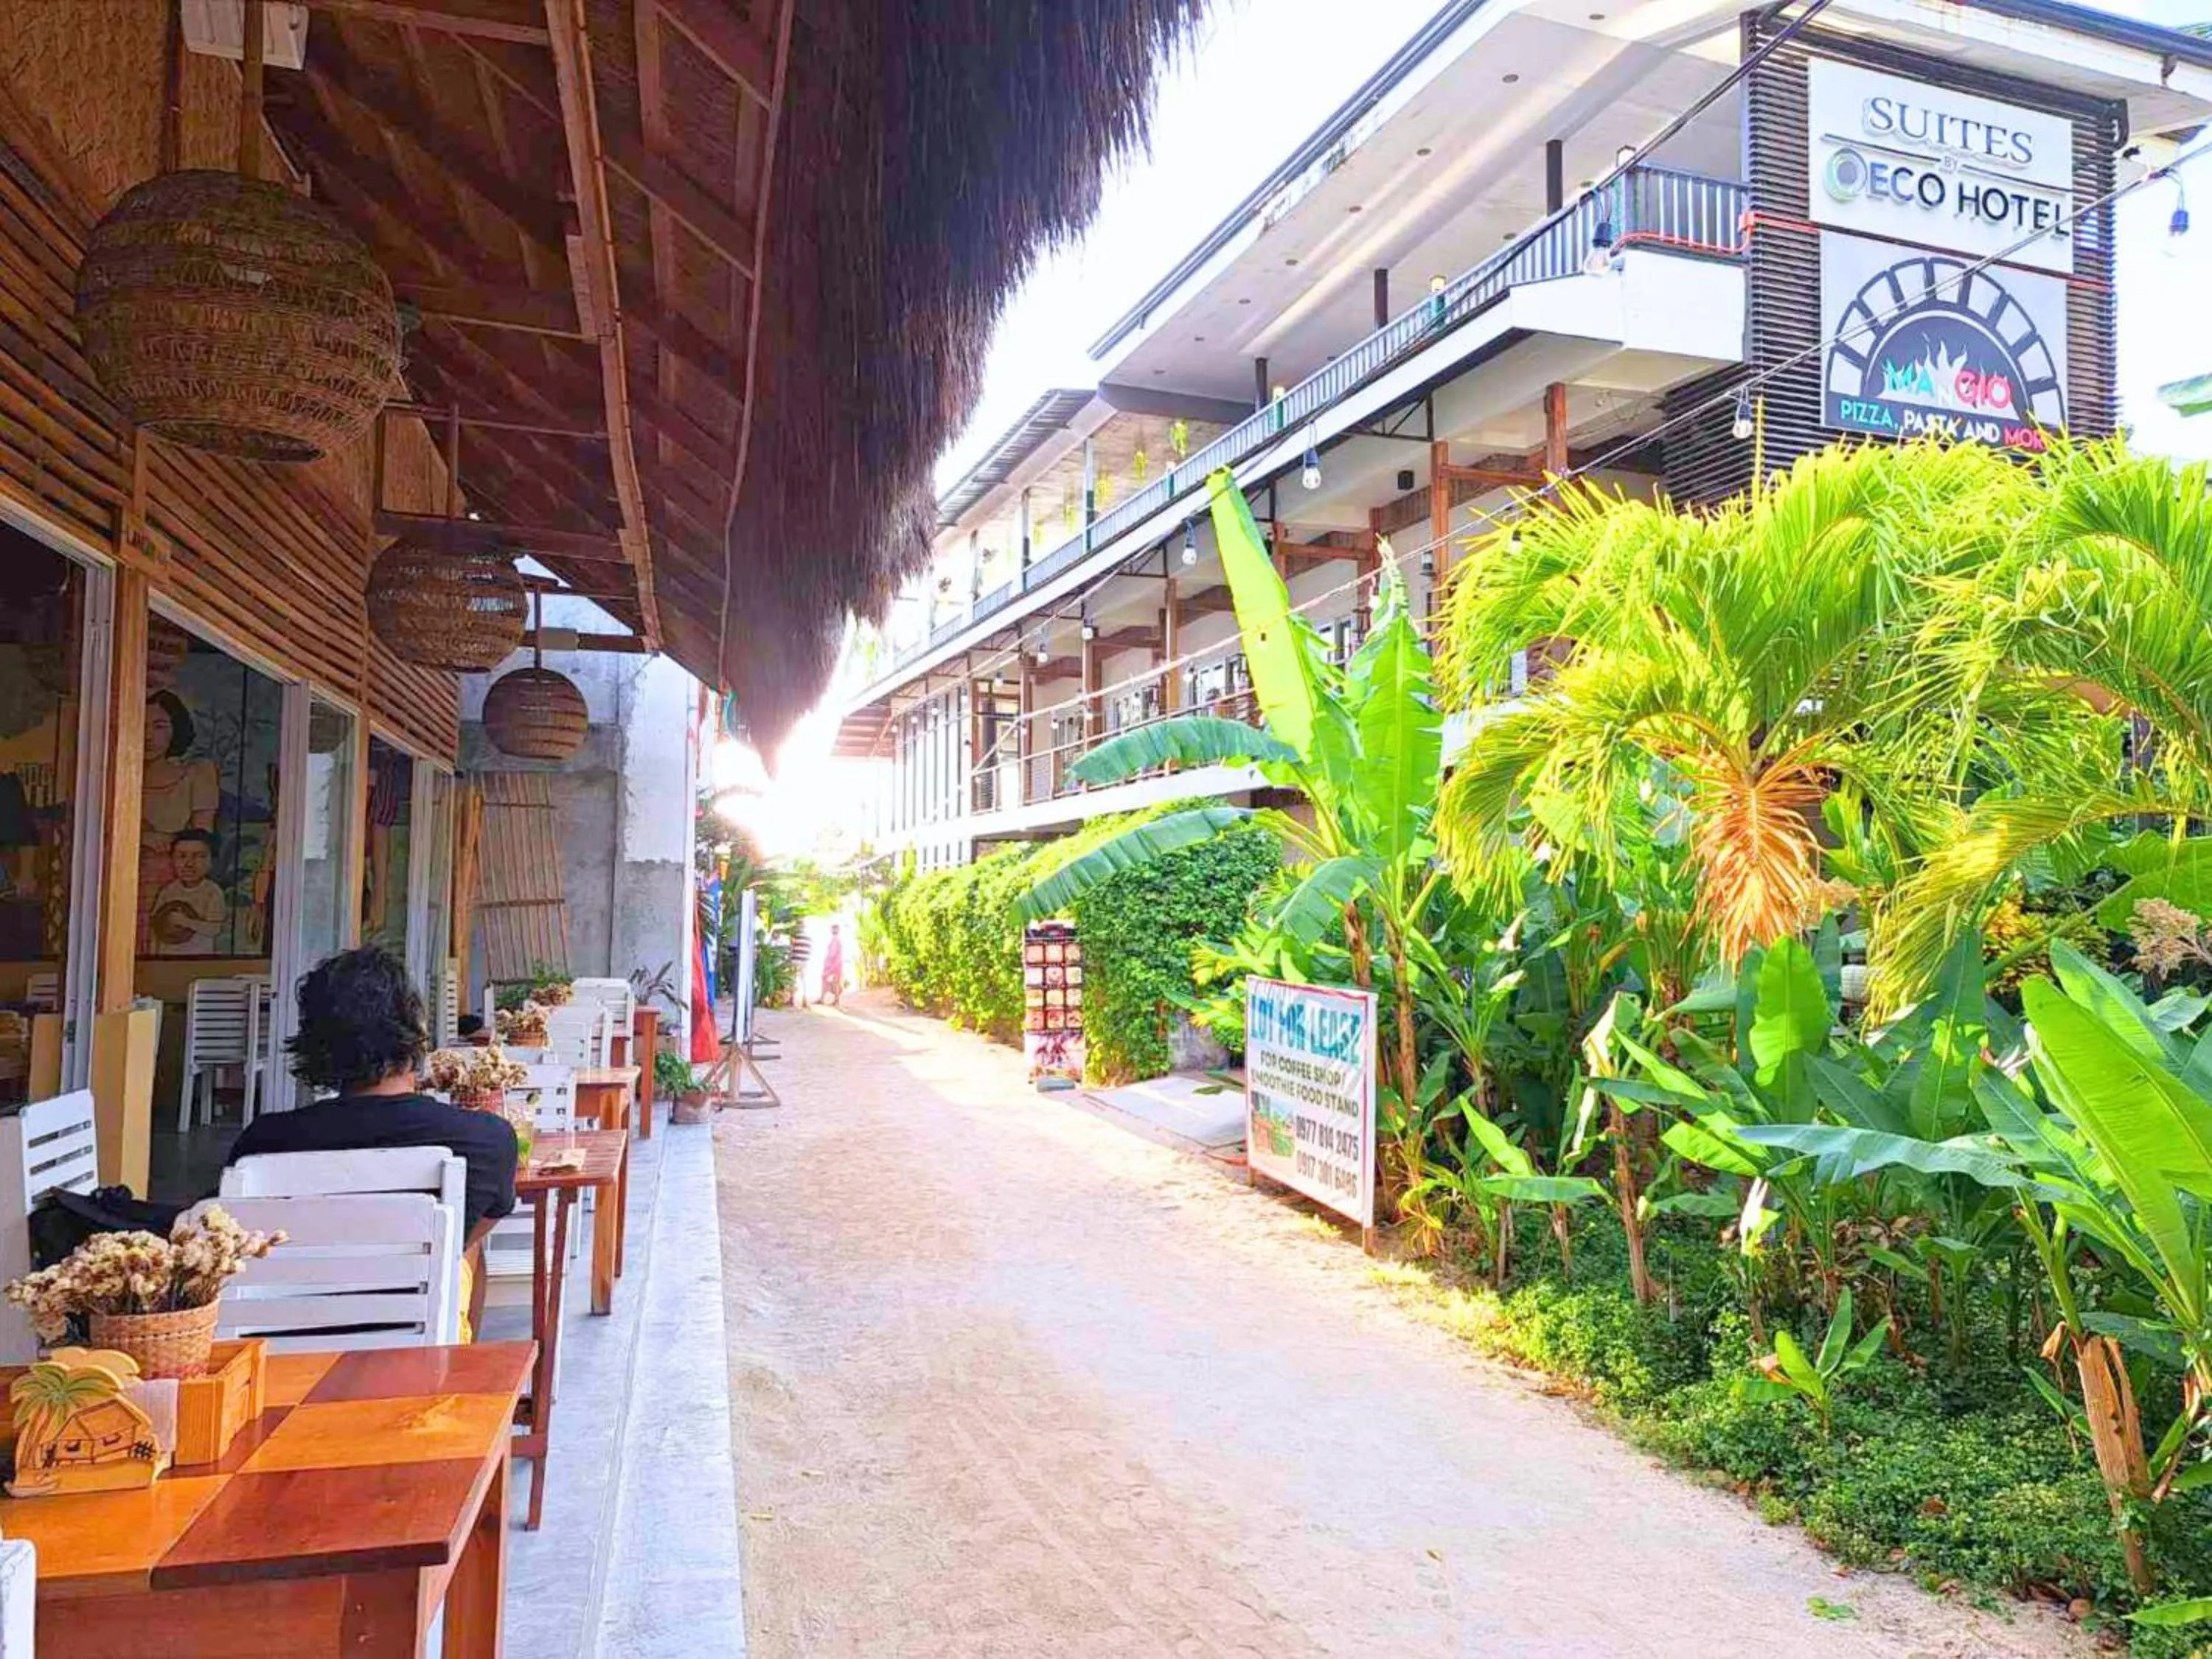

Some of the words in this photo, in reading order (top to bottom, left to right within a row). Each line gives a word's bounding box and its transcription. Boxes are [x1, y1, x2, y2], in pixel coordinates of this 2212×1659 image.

[1869, 97, 2033, 164] SUITES
[1943, 155, 1960, 170] BY
[1869, 161, 1946, 207] ECO
[1958, 182, 2070, 237] HOTEL
[1840, 400, 1899, 431] PIZZA,
[1903, 410, 1958, 439] PASTA
[1964, 422, 2000, 443] AND
[2003, 427, 2048, 451] MOR
[1260, 1050, 1276, 1067] FOR
[1279, 1056, 1311, 1079] COFFEE
[1297, 1082, 1323, 1105] FOOD
[1325, 1092, 1359, 1117] STAND
